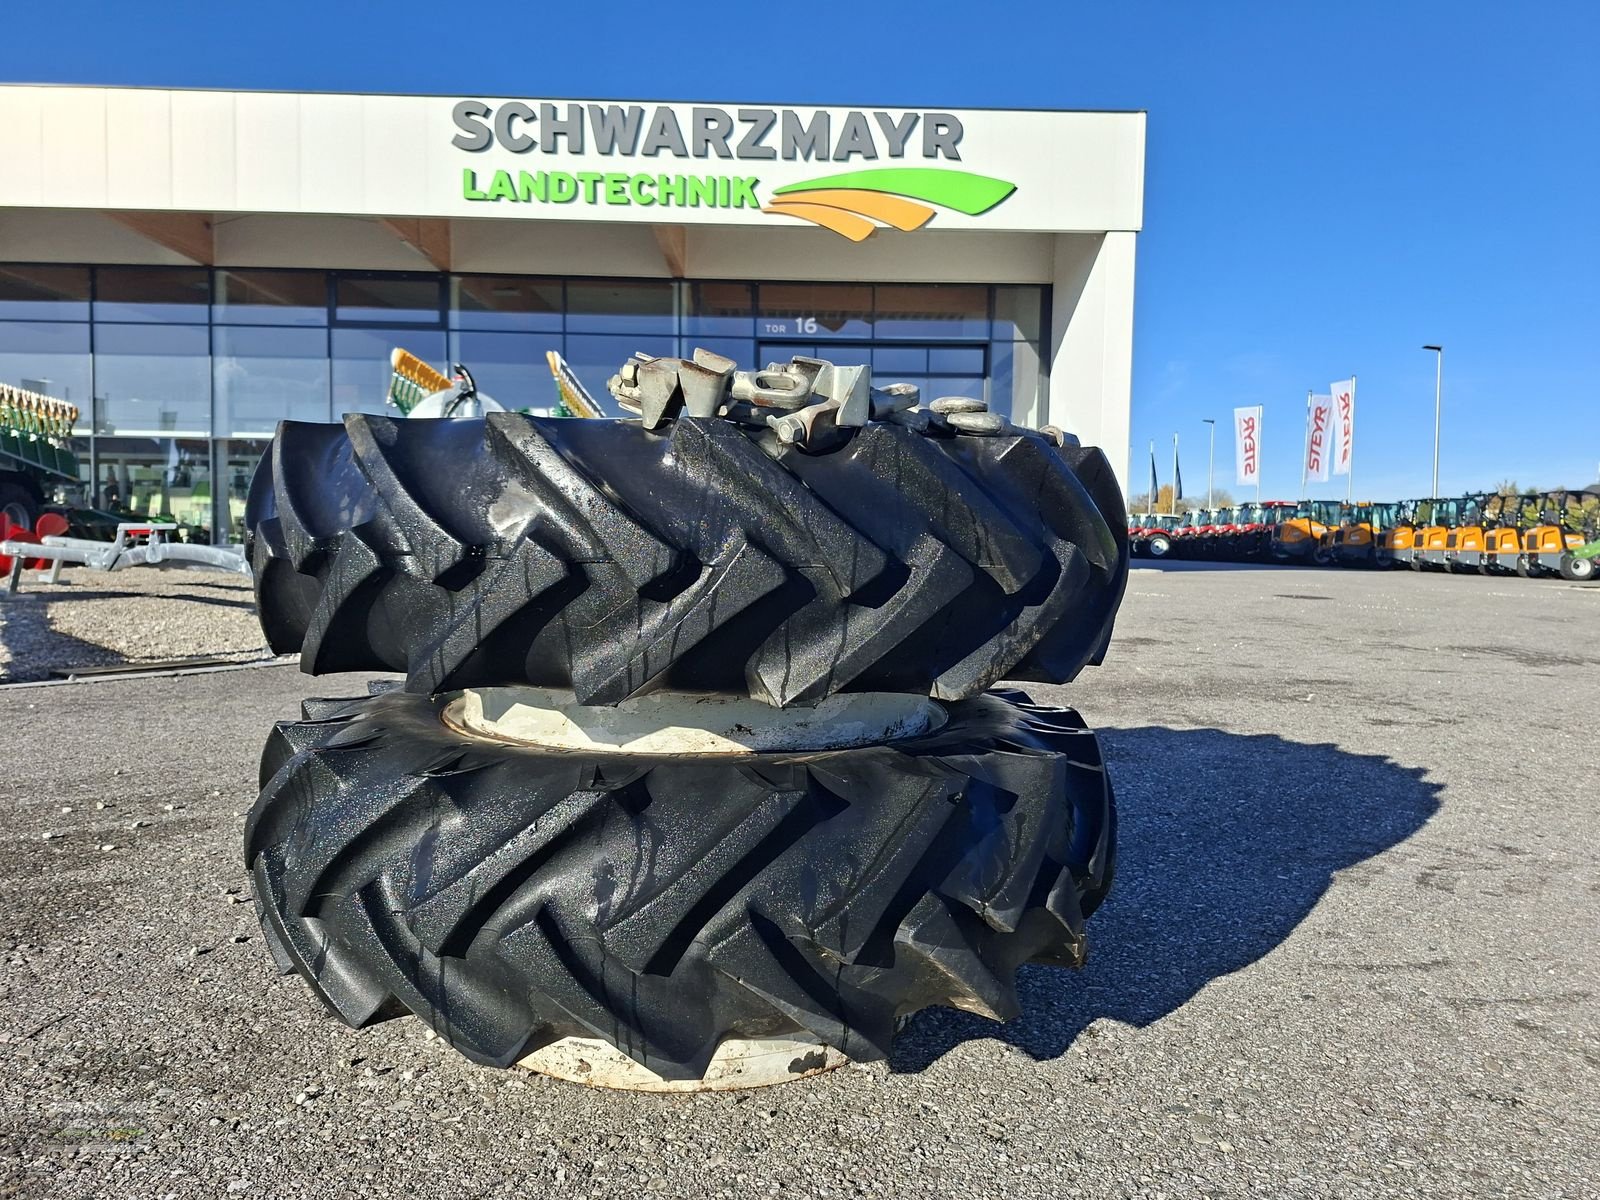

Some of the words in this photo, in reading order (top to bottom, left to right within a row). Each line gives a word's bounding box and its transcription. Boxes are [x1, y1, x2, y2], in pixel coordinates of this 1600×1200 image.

[452, 100, 964, 161] SCHWARZMAYR
[463, 168, 761, 208] LANDTECHNIK
[765, 324, 786, 333] TOR
[795, 317, 817, 334] 16
[1309, 406, 1327, 472] STEYR
